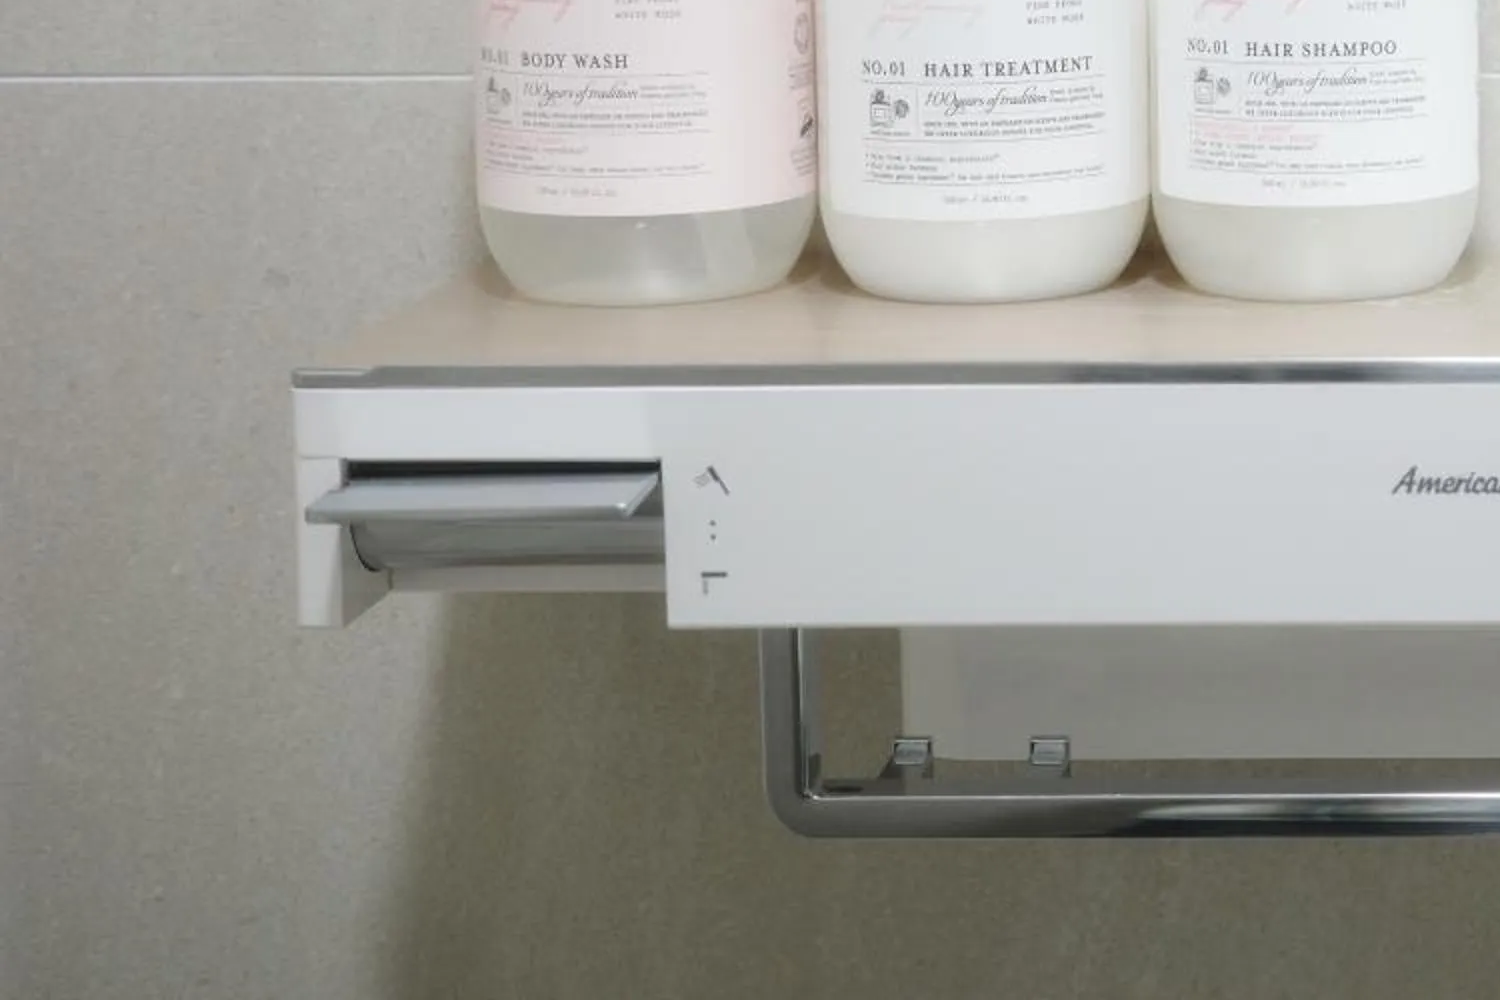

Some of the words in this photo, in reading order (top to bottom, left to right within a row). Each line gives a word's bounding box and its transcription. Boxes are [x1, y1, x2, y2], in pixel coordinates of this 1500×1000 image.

[1186, 39, 1230, 56] NO.01
[1244, 41, 1294, 58] HAIR
[1301, 39, 1398, 59] SHAMPOO
[519, 52, 566, 70] BODY
[571, 53, 630, 70] WASH
[860, 59, 906, 77] NO.01
[924, 61, 974, 79] HAIR
[981, 55, 1093, 79] TREATMENT
